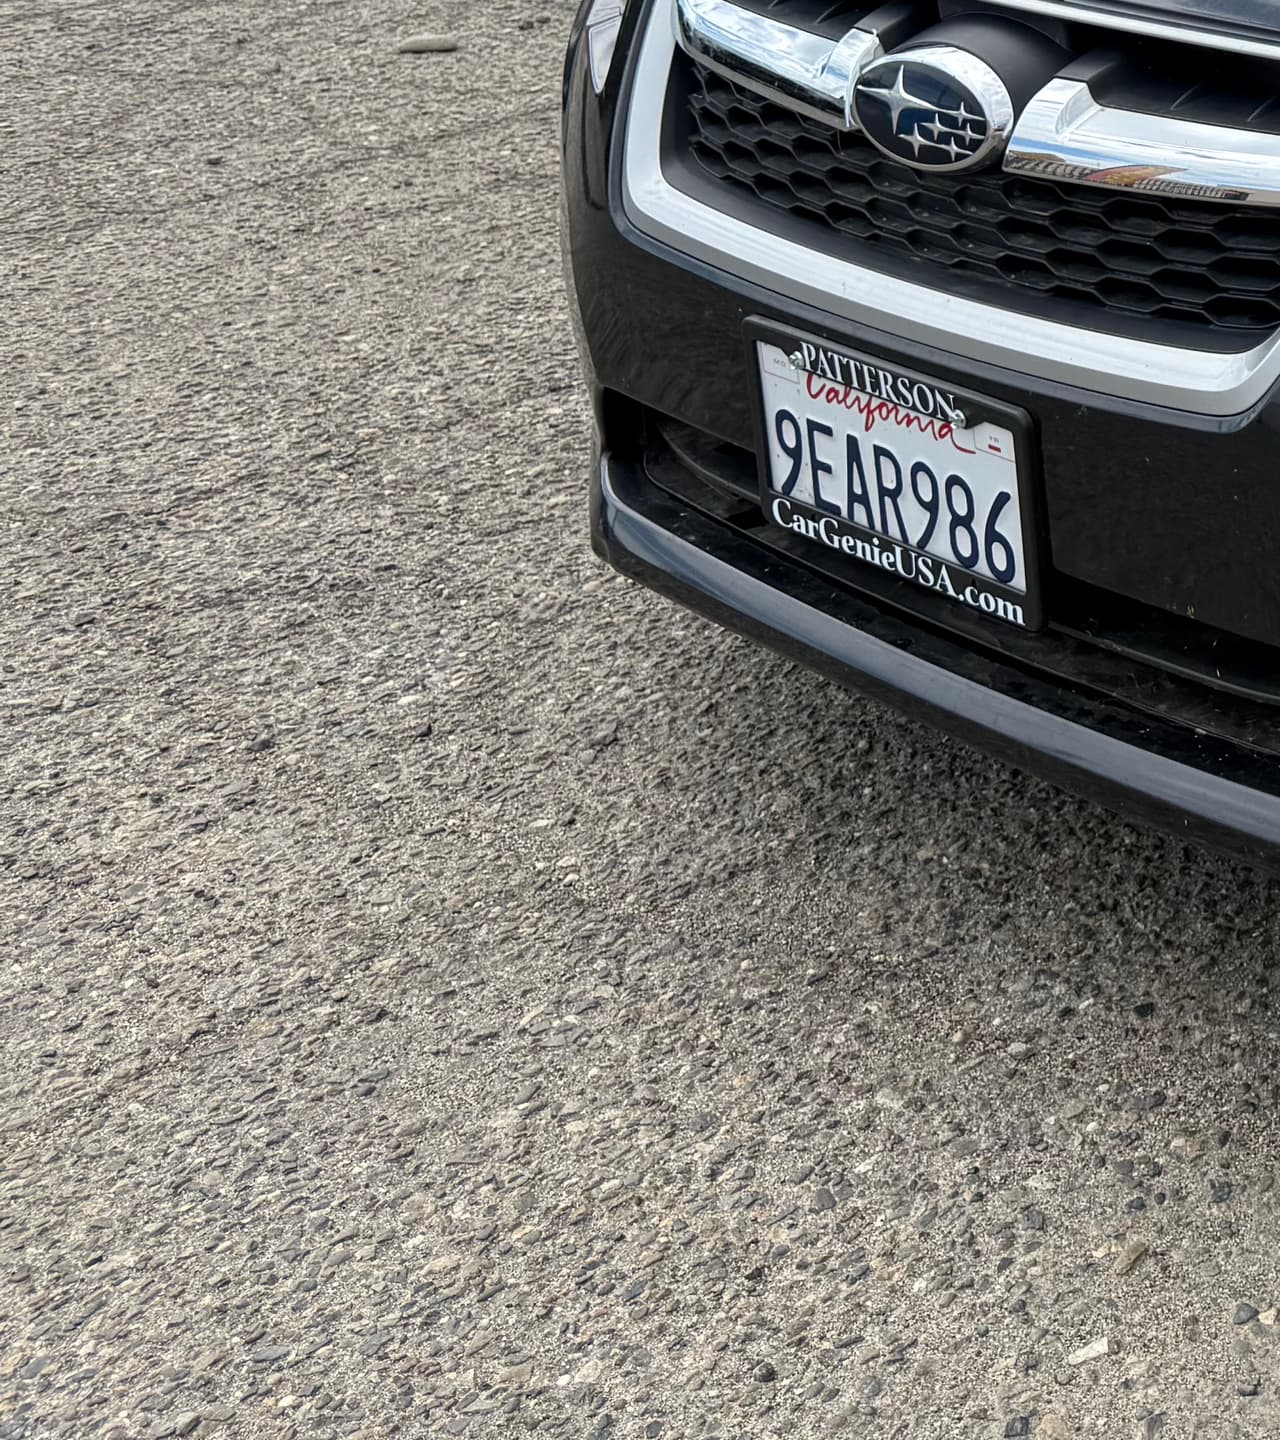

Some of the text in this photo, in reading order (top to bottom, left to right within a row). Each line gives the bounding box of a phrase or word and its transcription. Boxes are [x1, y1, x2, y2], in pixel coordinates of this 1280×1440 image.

[799, 341, 958, 420] PATTERSON
[775, 408, 1016, 584] 9EAR986
[771, 498, 1026, 627] CarGenieUSA.com
